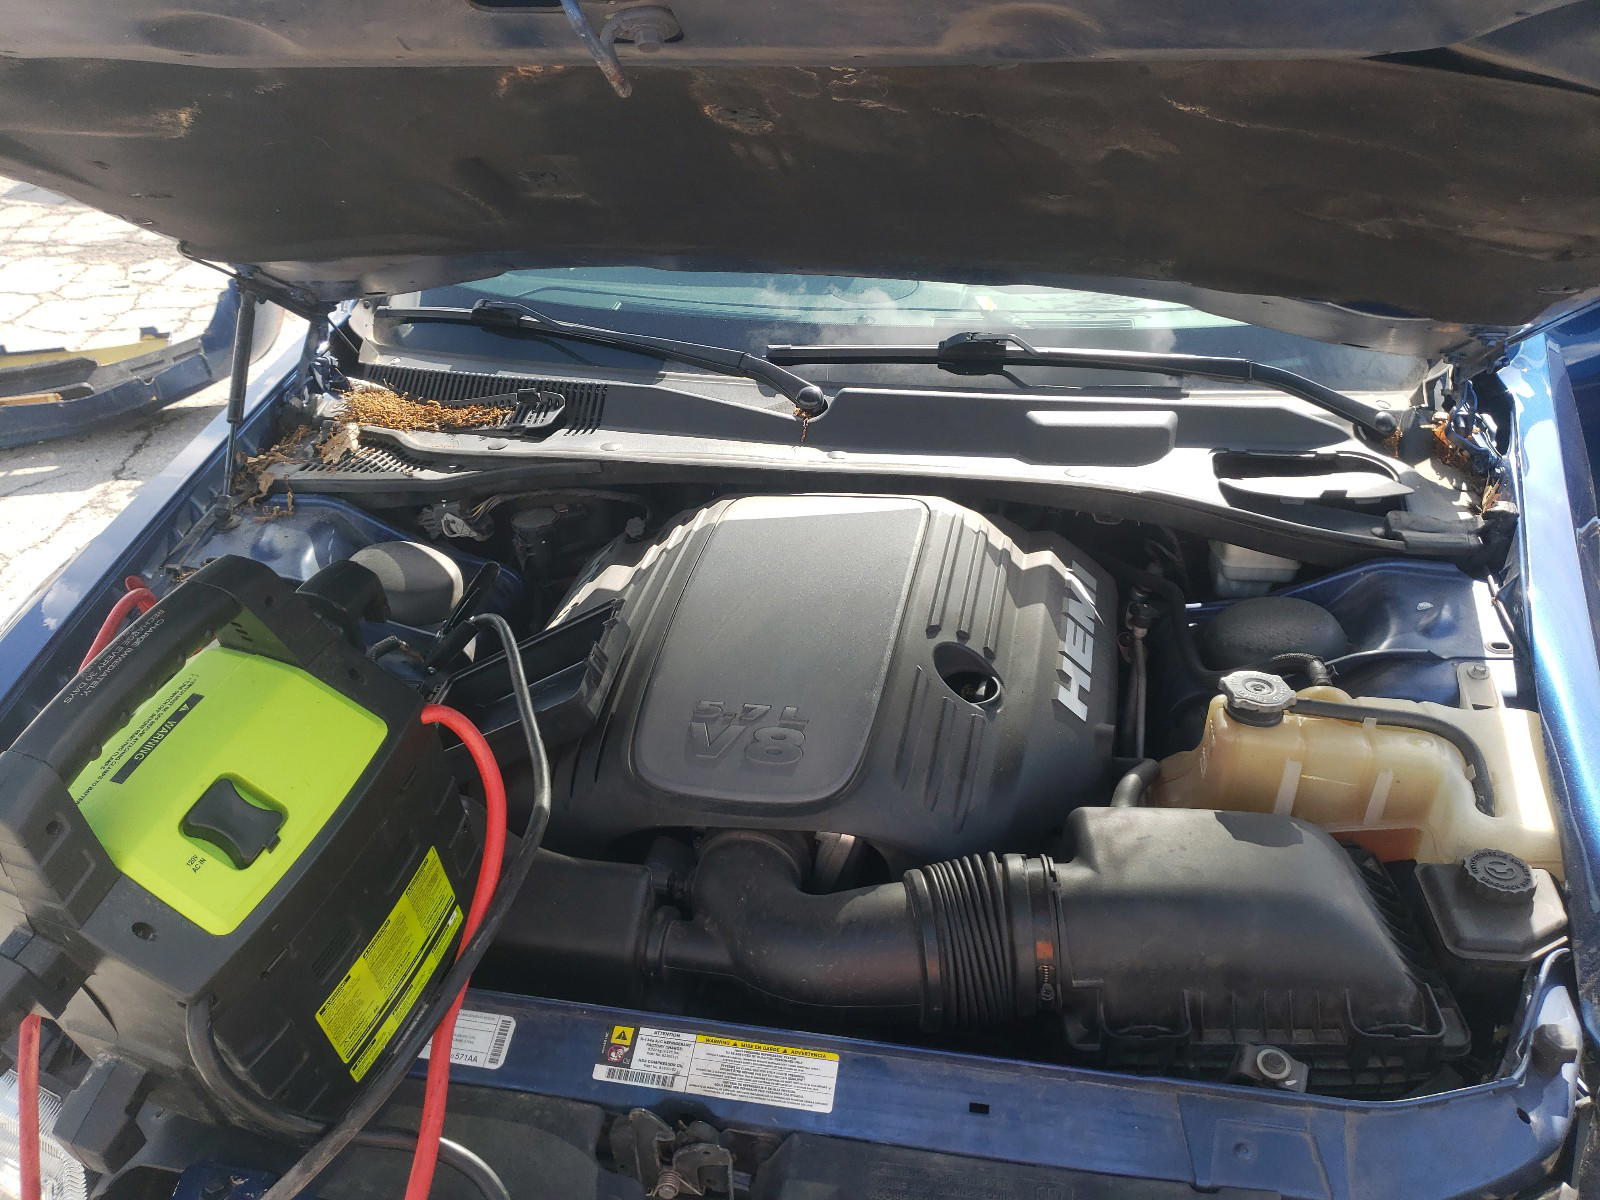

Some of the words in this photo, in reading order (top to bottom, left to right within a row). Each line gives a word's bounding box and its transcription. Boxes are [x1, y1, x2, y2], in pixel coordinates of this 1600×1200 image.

[131, 619, 165, 649] CHARGE
[1058, 560, 1097, 722] HEMI
[97, 646, 124, 671] EVERY
[86, 672, 98, 682] 30
[63, 681, 87, 704] DAYS
[134, 720, 177, 761] WARNING
[690, 721, 806, 766] V8
[74, 786, 92, 805] BATTER
[192, 863, 201, 873] AC
[705, 1038, 729, 1046] WARNING
[790, 1049, 827, 1059] ADVERTENCIA
